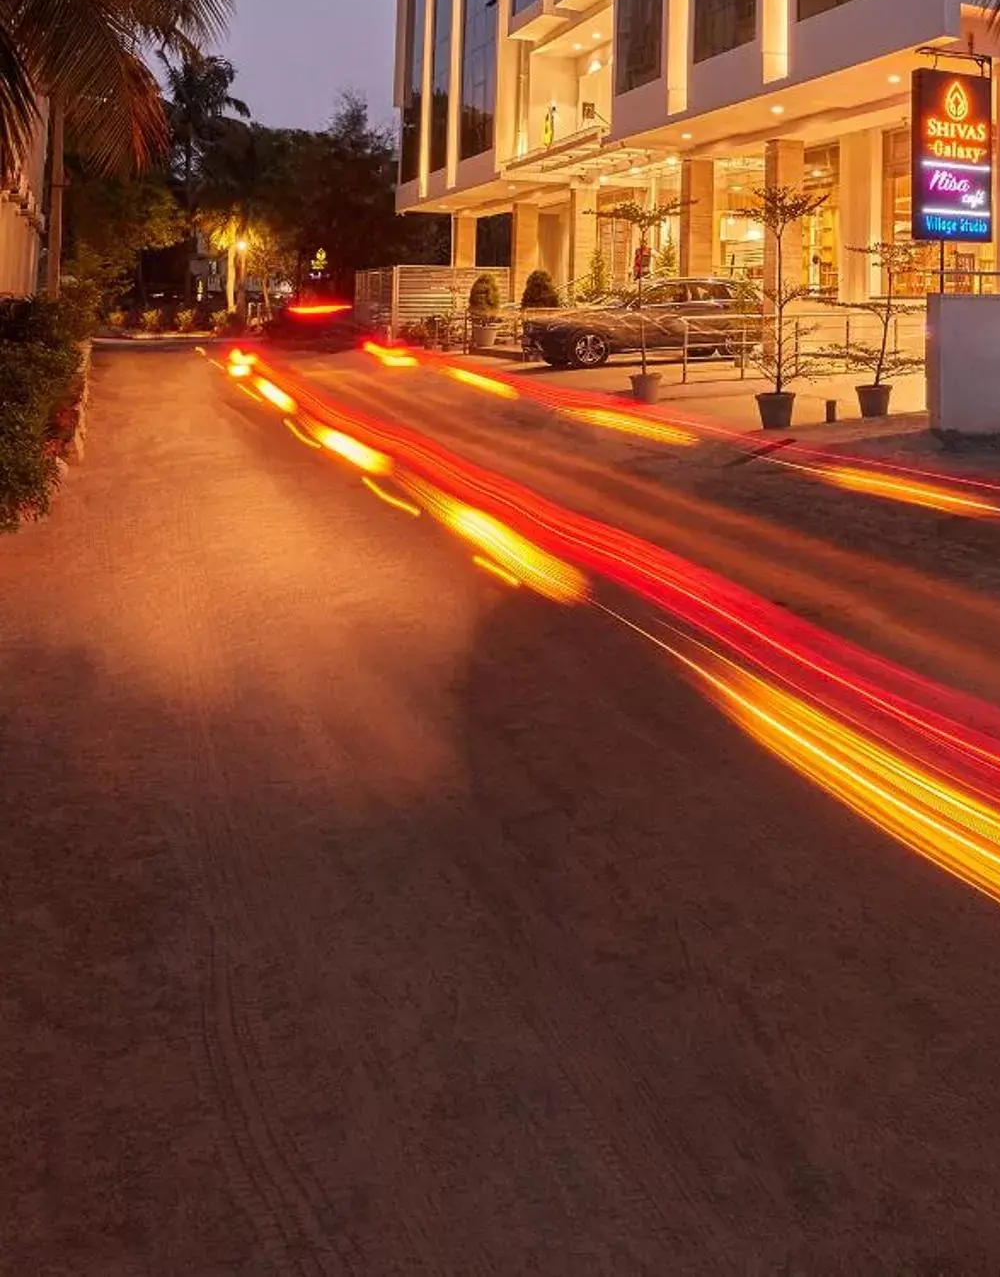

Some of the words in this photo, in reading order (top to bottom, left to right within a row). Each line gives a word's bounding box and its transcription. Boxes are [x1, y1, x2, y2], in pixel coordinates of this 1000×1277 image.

[927, 118, 986, 141] SHIVAS
[933, 140, 981, 163] Galaxy
[926, 216, 956, 233] Village
[960, 217, 988, 233] Studio
